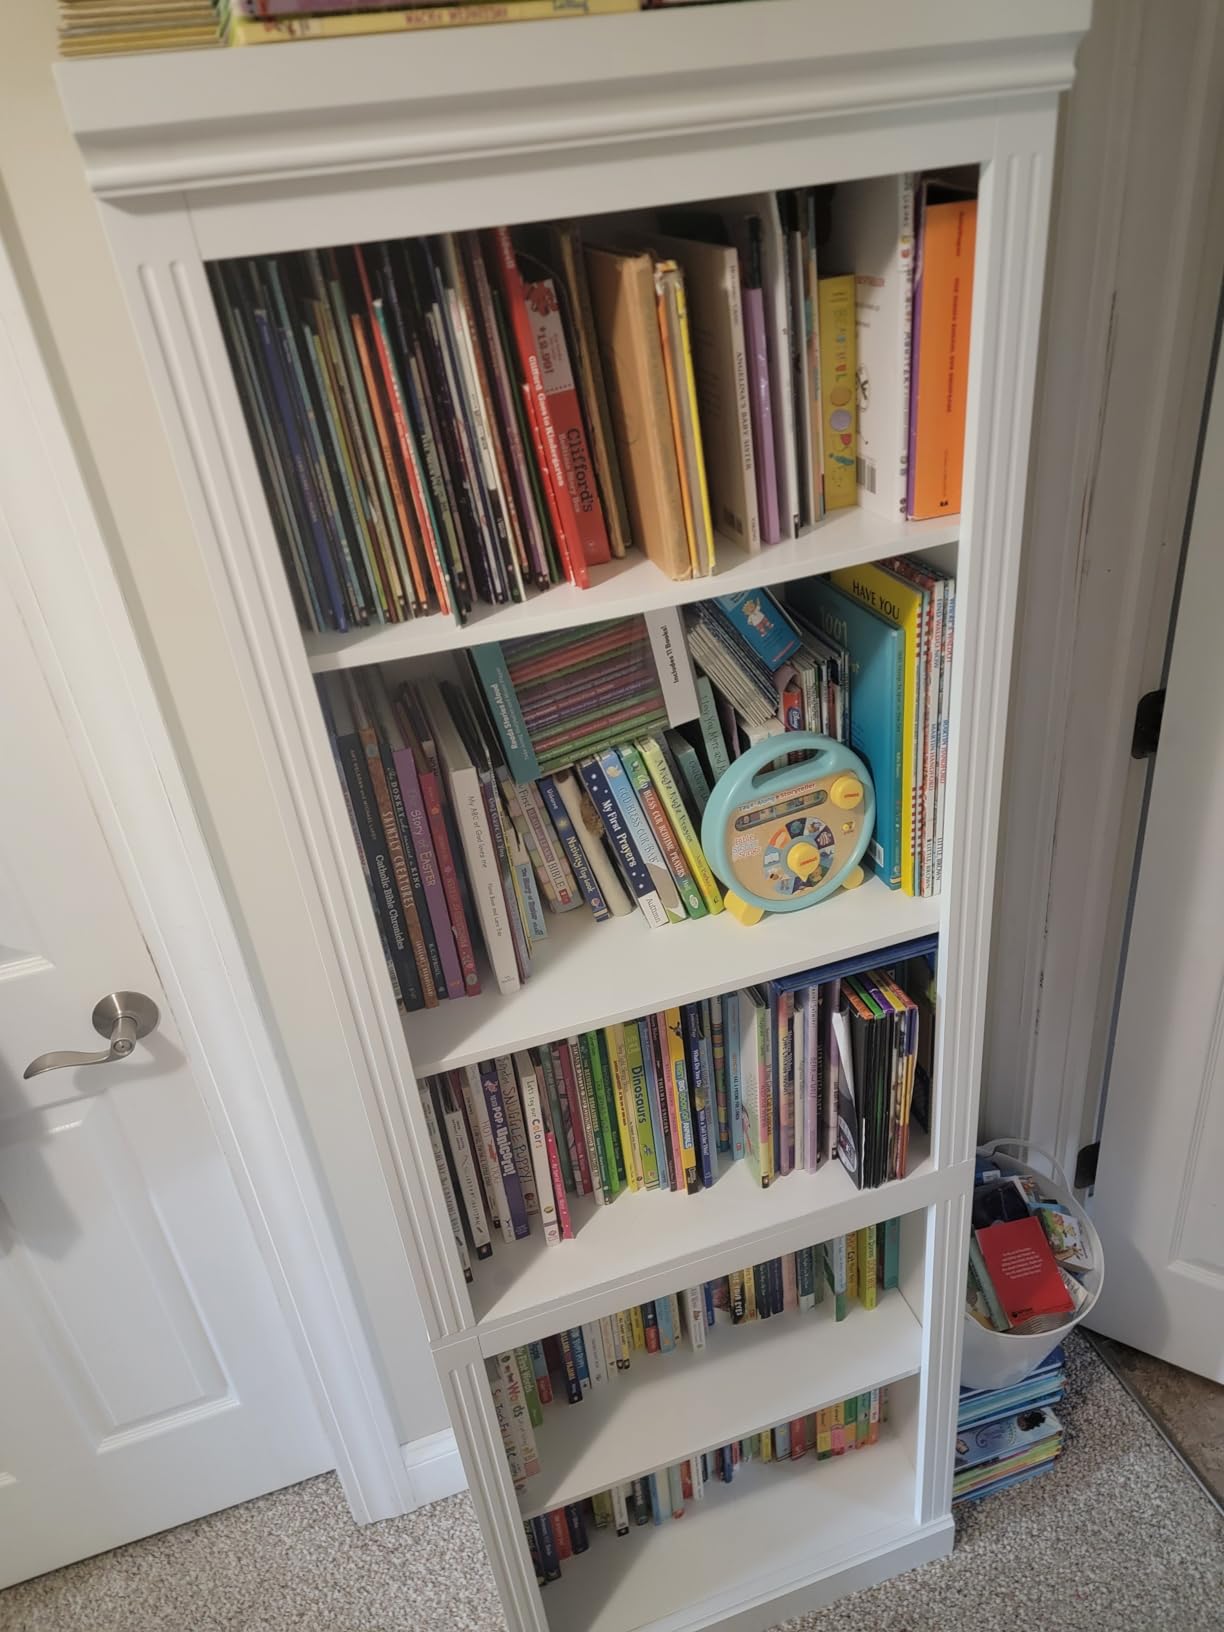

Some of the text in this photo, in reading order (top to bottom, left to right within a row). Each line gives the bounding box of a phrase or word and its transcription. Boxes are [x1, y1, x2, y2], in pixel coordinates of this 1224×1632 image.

[527, 355, 565, 487] Clifford Goes to Kindergarten
[736, 351, 753, 471] ANGELINA'S BABY SISTER
[568, 426, 593, 513] Clifford's
[853, 580, 900, 620] HAVE YOU
[660, 624, 679, 683] Includes 11 Books!
[490, 682, 518, 749] Reads Stories Aloud
[704, 716, 717, 730] You
[708, 730, 722, 750] More
[713, 750, 725, 764] and
[466, 795, 476, 807] My
[517, 788, 534, 808] First
[656, 766, 674, 791] Night
[666, 790, 683, 815] Night
[676, 814, 695, 844] Prayer
[780, 783, 816, 801] Storyteller
[469, 806, 479, 821] ABC
[617, 785, 650, 845] GOD BLESS OUR
[636, 773, 687, 878] GOD BLESS OUR BEDTIME PRAYERS
[389, 781, 404, 818] DONKEY
[410, 866, 421, 889] KING
[408, 808, 425, 837] Story
[419, 850, 438, 886] EASTER
[474, 829, 484, 843] God
[599, 798, 638, 869] My First Prayers
[382, 810, 414, 909] SAINTLY CREATURES
[547, 862, 565, 889] BIBLE
[564, 835, 596, 894] Nativity flap book
[374, 853, 405, 950] Catholic Bible Chronicles
[645, 896, 661, 923] Autumn
[674, 1061, 684, 1080] FIRST
[695, 1061, 700, 1069] Do
[584, 1068, 593, 1096] REINDEER
[631, 1064, 646, 1124] Dinosaurs
[676, 1079, 685, 1092] BIG
[491, 1105, 504, 1125] POP
[587, 1096, 599, 1132] REMAINDERS
[678, 1092, 688, 1111] BOOK
[680, 1110, 689, 1121] OF
[501, 1086, 525, 1143] SNUGGLE
[513, 1143, 533, 1185] PUPPY!
[530, 1117, 544, 1149] Colors
[681, 1121, 692, 1148] ANIMALS
[495, 1125, 516, 1177] Unicorn!
[735, 1300, 743, 1316] EYES
[521, 1369, 534, 1393] Words
[506, 1381, 525, 1419] Words
